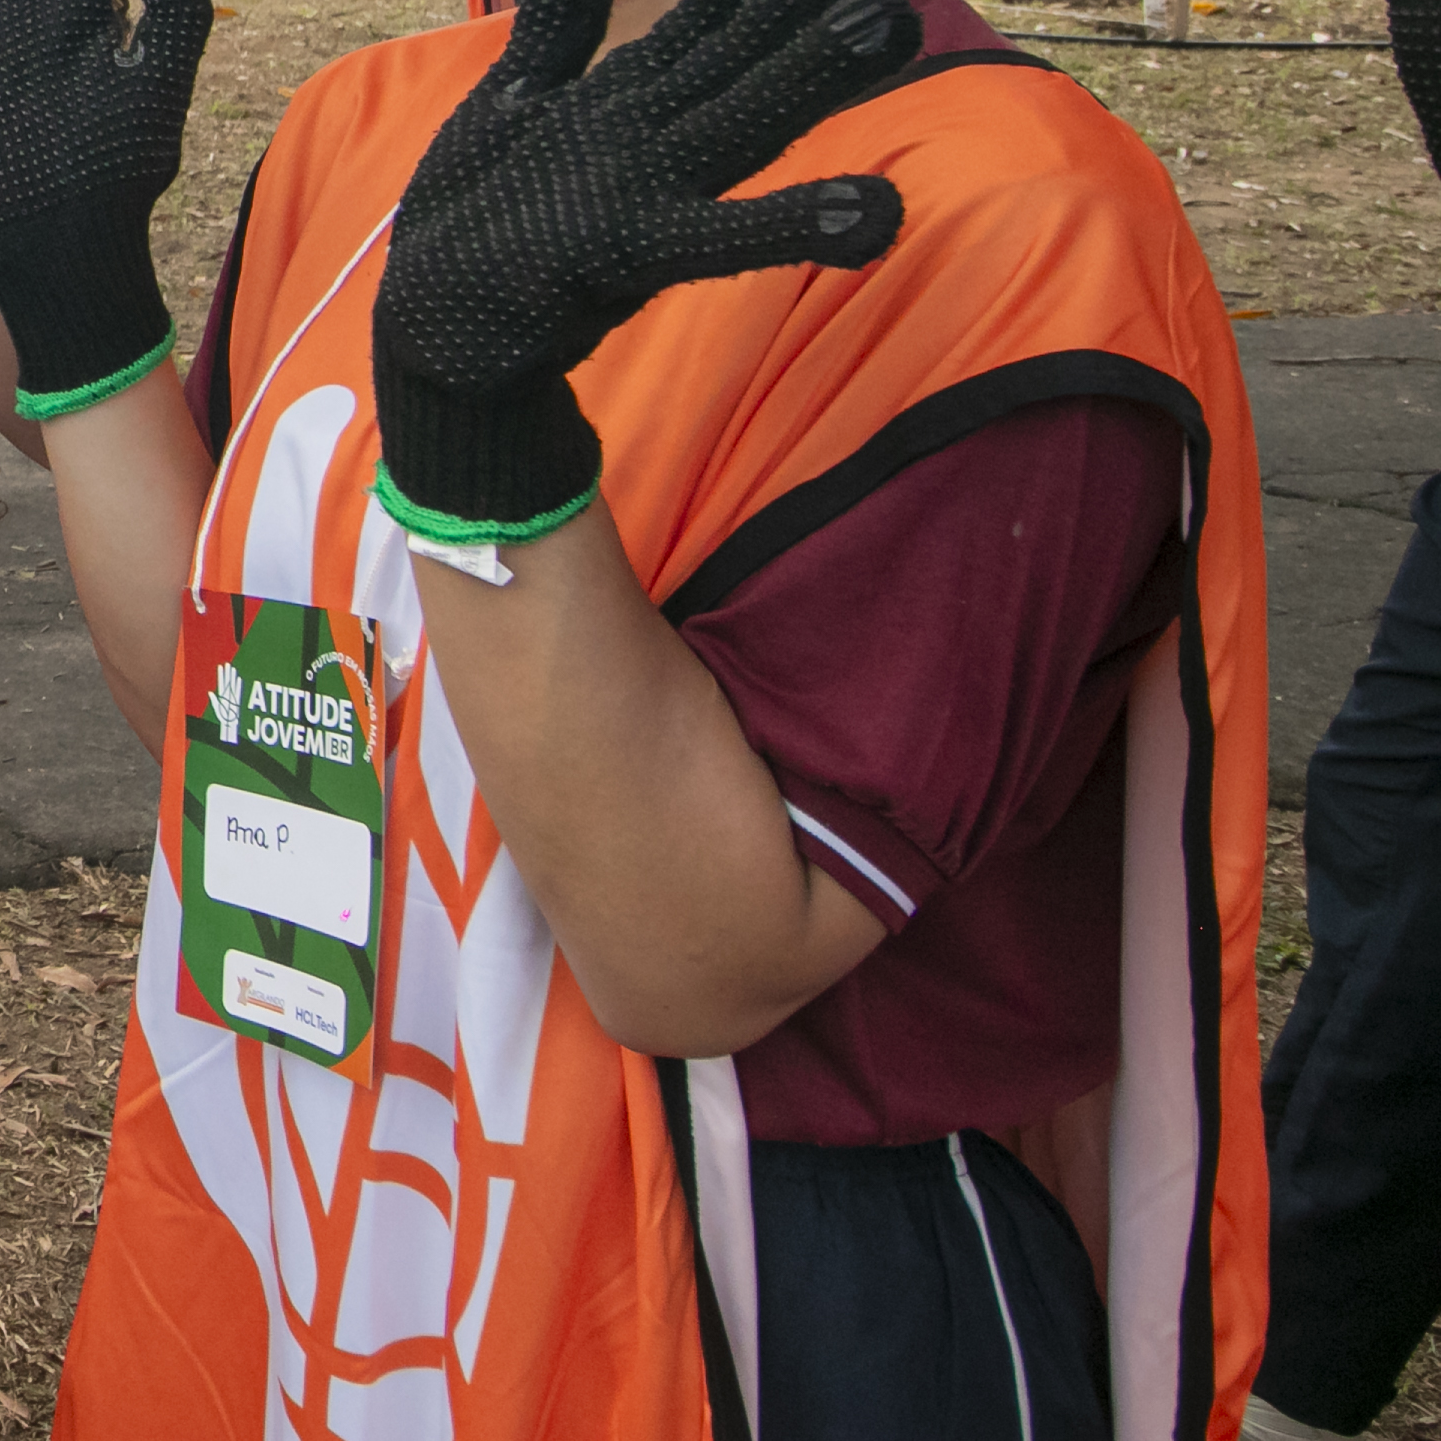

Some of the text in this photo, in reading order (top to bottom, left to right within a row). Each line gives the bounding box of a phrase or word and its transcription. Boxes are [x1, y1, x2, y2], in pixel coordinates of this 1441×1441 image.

[311, 651, 345, 673] FUTURO
[344, 654, 359, 672] EM
[247, 680, 353, 733] ATITUDE
[247, 715, 325, 757] JOVEM
[226, 815, 269, 849] Ana
[295, 1006, 339, 1037] HCLTech
